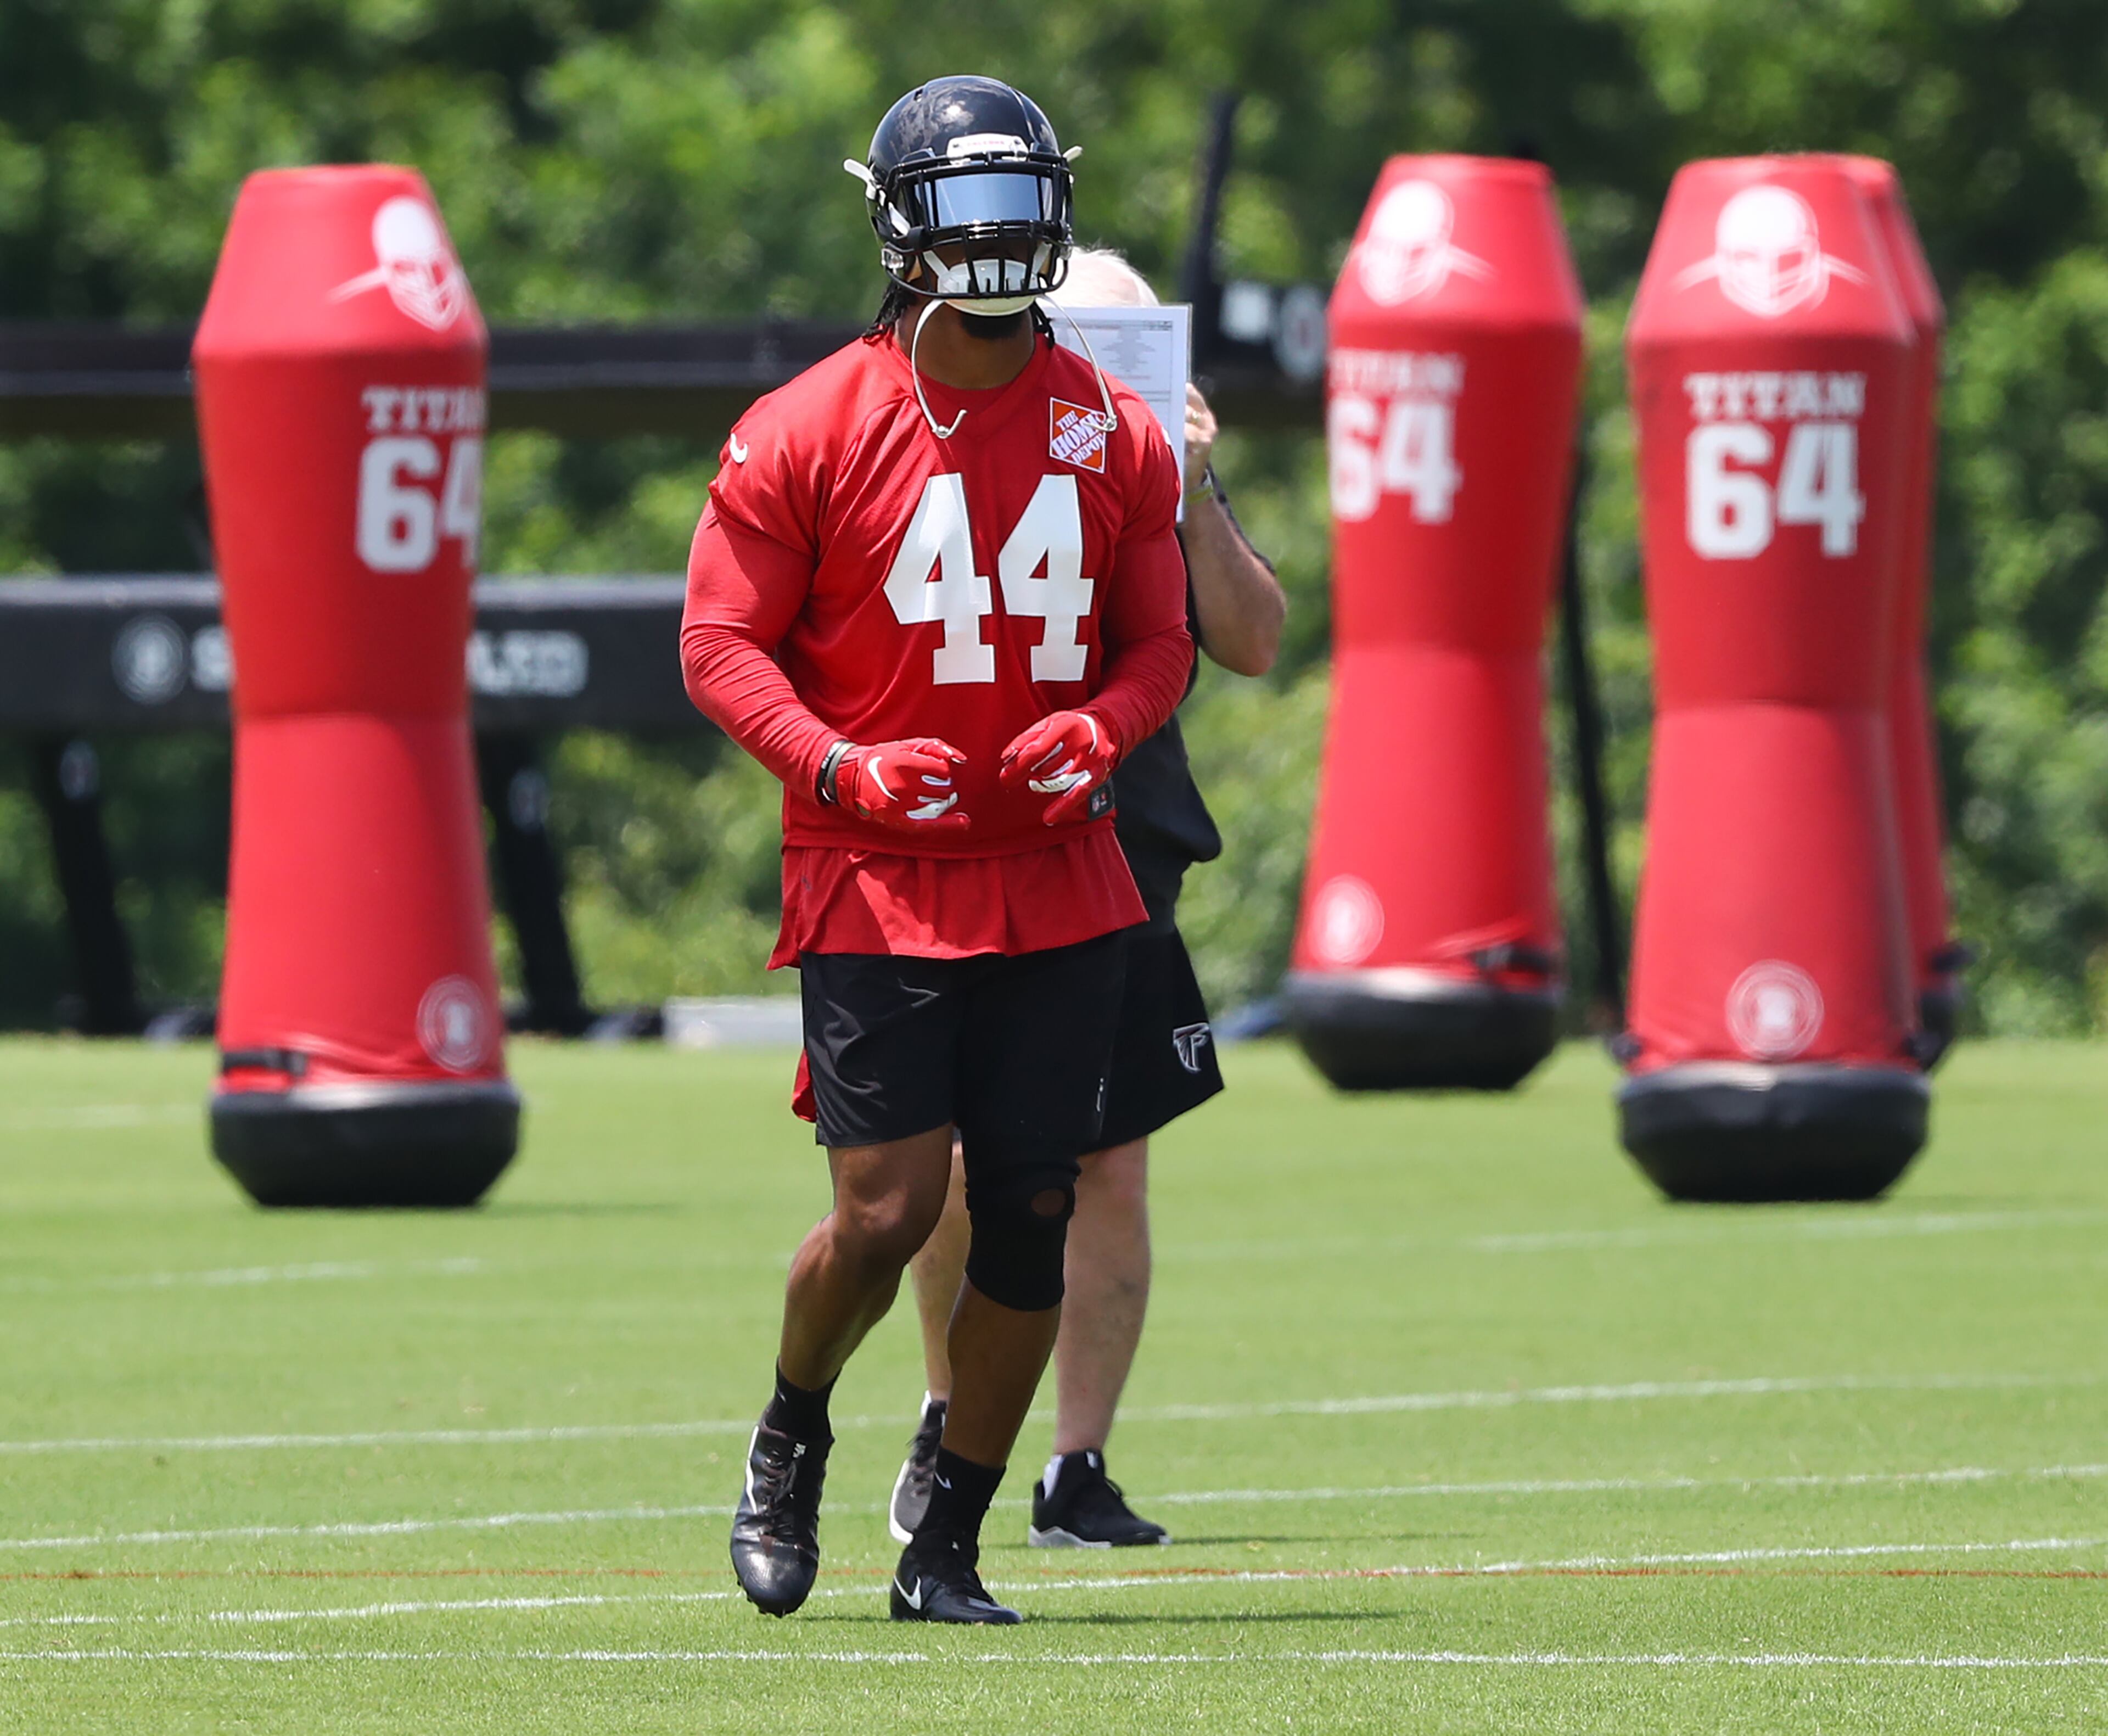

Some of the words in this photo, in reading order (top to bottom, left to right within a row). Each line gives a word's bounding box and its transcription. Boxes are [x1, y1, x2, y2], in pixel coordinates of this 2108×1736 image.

[1055, 410, 1079, 432] THE
[1328, 392, 1464, 523] 64
[1684, 371, 1866, 419] TITAN
[356, 436, 483, 572] 64
[1686, 422, 1866, 559] 64
[883, 472, 1094, 685] 44
